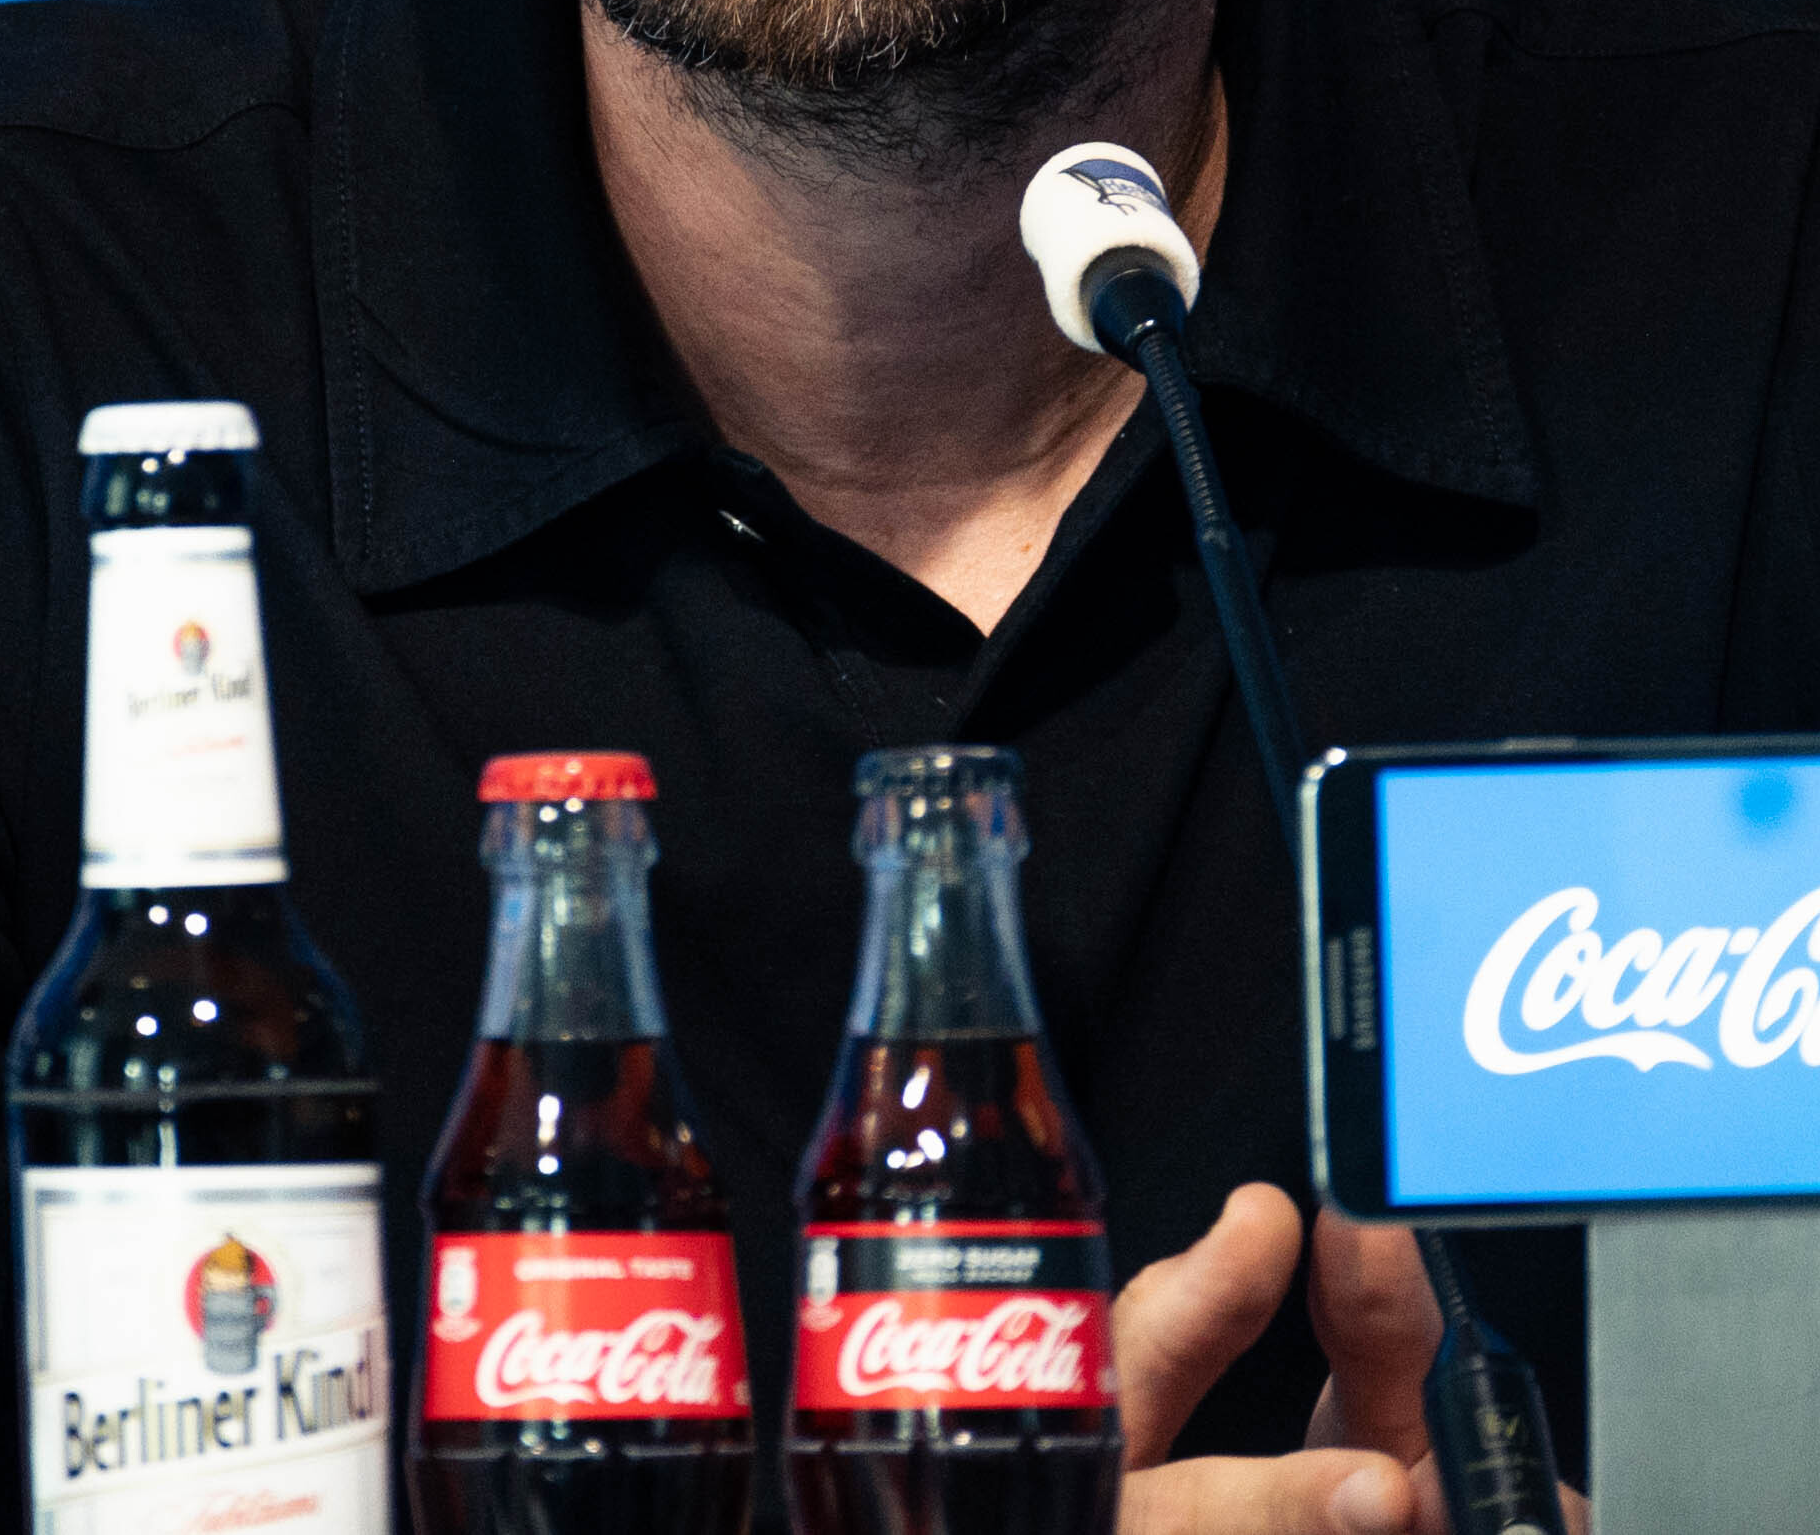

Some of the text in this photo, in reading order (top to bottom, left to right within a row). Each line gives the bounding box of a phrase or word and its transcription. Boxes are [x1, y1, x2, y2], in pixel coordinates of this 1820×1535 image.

[475, 1309, 724, 1408] Coca-Cola
[837, 1297, 1089, 1397] Coca-Cola
[64, 1376, 258, 1479] Berliner
